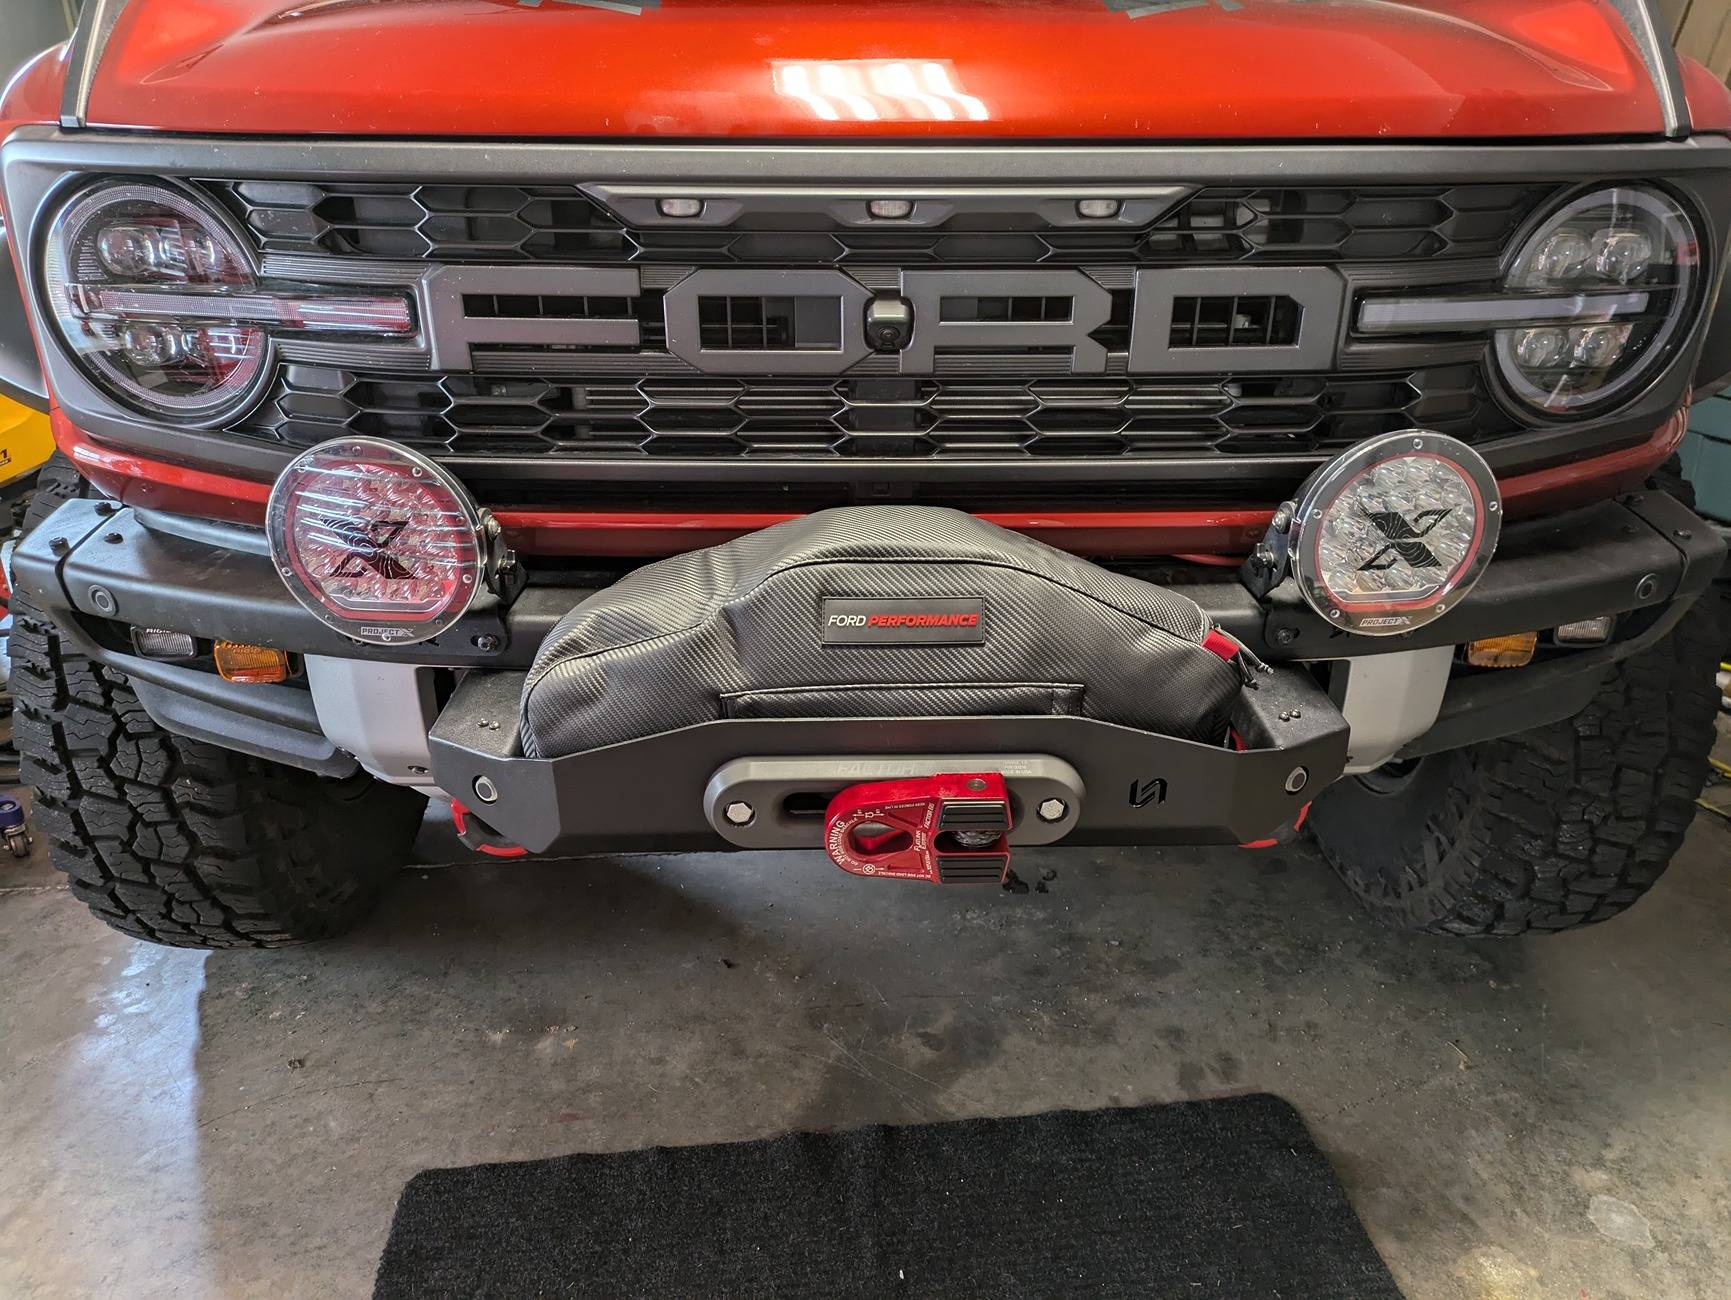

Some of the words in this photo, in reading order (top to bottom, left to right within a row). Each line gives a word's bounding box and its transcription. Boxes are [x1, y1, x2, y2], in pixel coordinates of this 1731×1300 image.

[424, 266, 1346, 374] FORD
[827, 615, 867, 627] FORD
[868, 613, 979, 628] PERFORMANCE
[829, 820, 845, 865] WARNING
